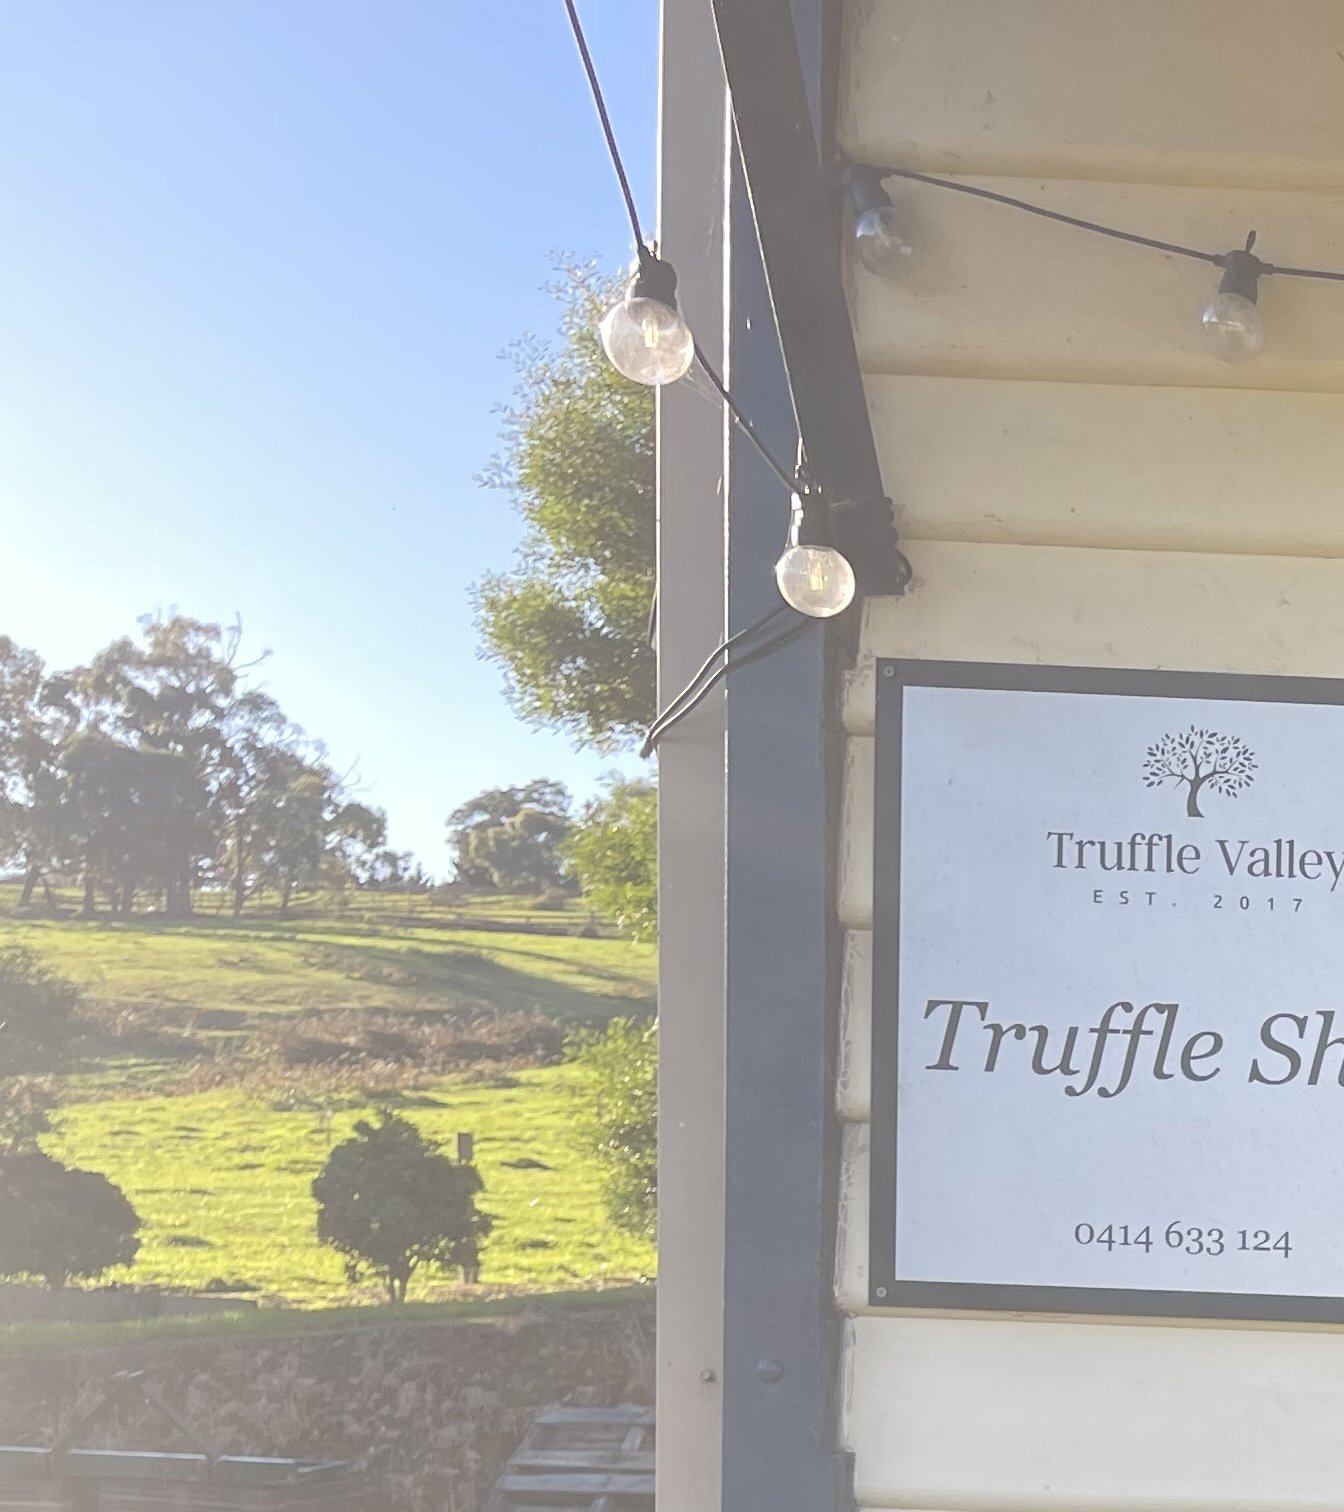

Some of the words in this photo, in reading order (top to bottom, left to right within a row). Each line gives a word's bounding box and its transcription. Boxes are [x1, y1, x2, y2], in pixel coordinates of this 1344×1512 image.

[1046, 831, 1201, 875] Truffle
[1093, 889, 1178, 908] EST.
[1213, 894, 1304, 914] 2017
[923, 999, 1224, 1099] Truffle
[1074, 1222, 1154, 1254] 0414
[1164, 1220, 1225, 1257] 633
[1236, 1229, 1293, 1259] 124
